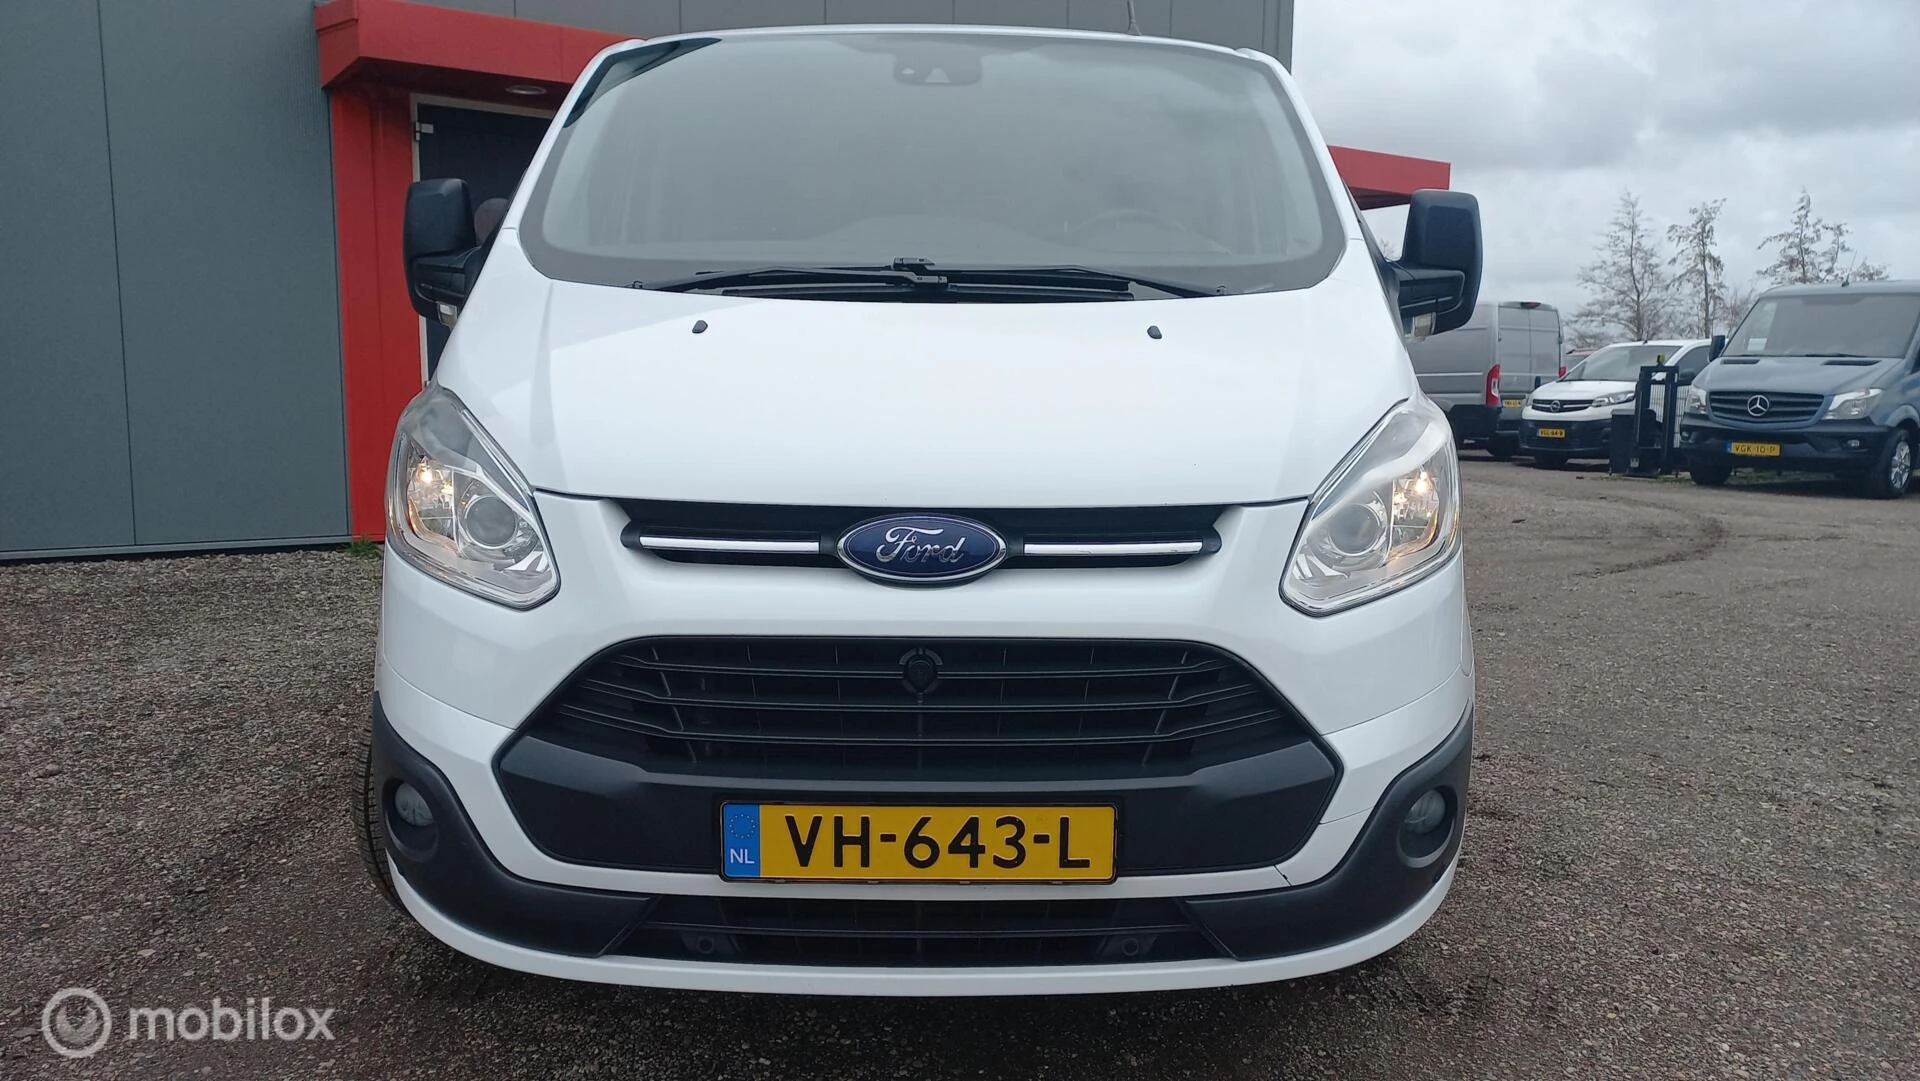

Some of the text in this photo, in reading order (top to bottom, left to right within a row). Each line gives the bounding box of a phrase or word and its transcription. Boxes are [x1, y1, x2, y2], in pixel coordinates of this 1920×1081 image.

[876, 526, 966, 563] Ford
[729, 848, 755, 864] NL
[784, 815, 1090, 868] VH-643-L
